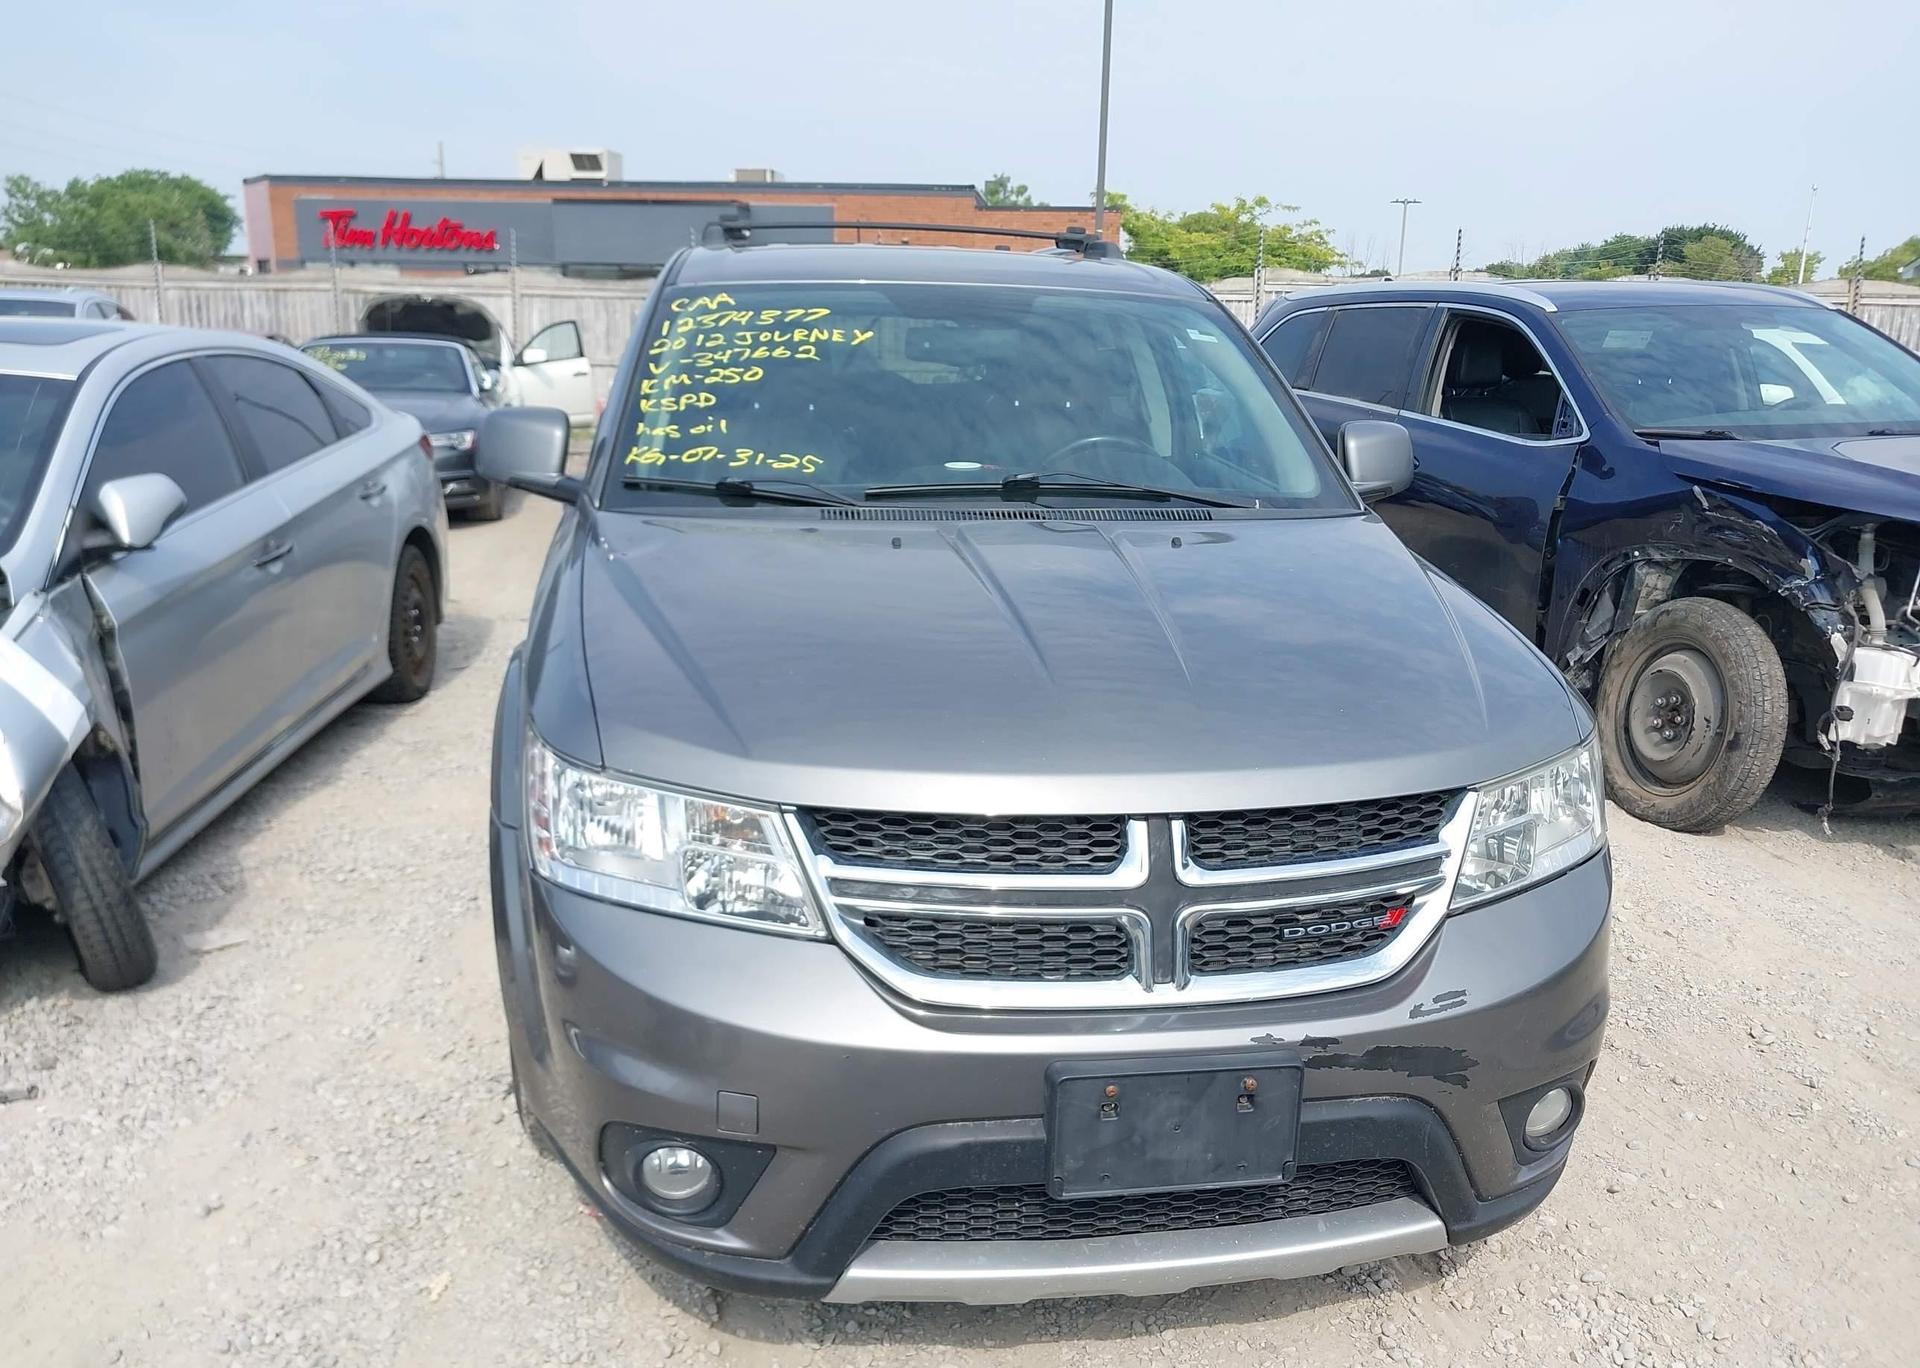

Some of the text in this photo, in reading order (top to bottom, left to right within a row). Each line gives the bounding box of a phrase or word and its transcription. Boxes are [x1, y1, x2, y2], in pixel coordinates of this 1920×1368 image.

[319, 208, 496, 250] Tim Hortons
[671, 292, 736, 312] CAA
[661, 308, 831, 336] 12374377
[649, 328, 874, 354] 2012 JOURNEY
[640, 392, 717, 413] KSPD
[636, 416, 727, 438] has oil
[1283, 914, 1392, 938] DODGE
